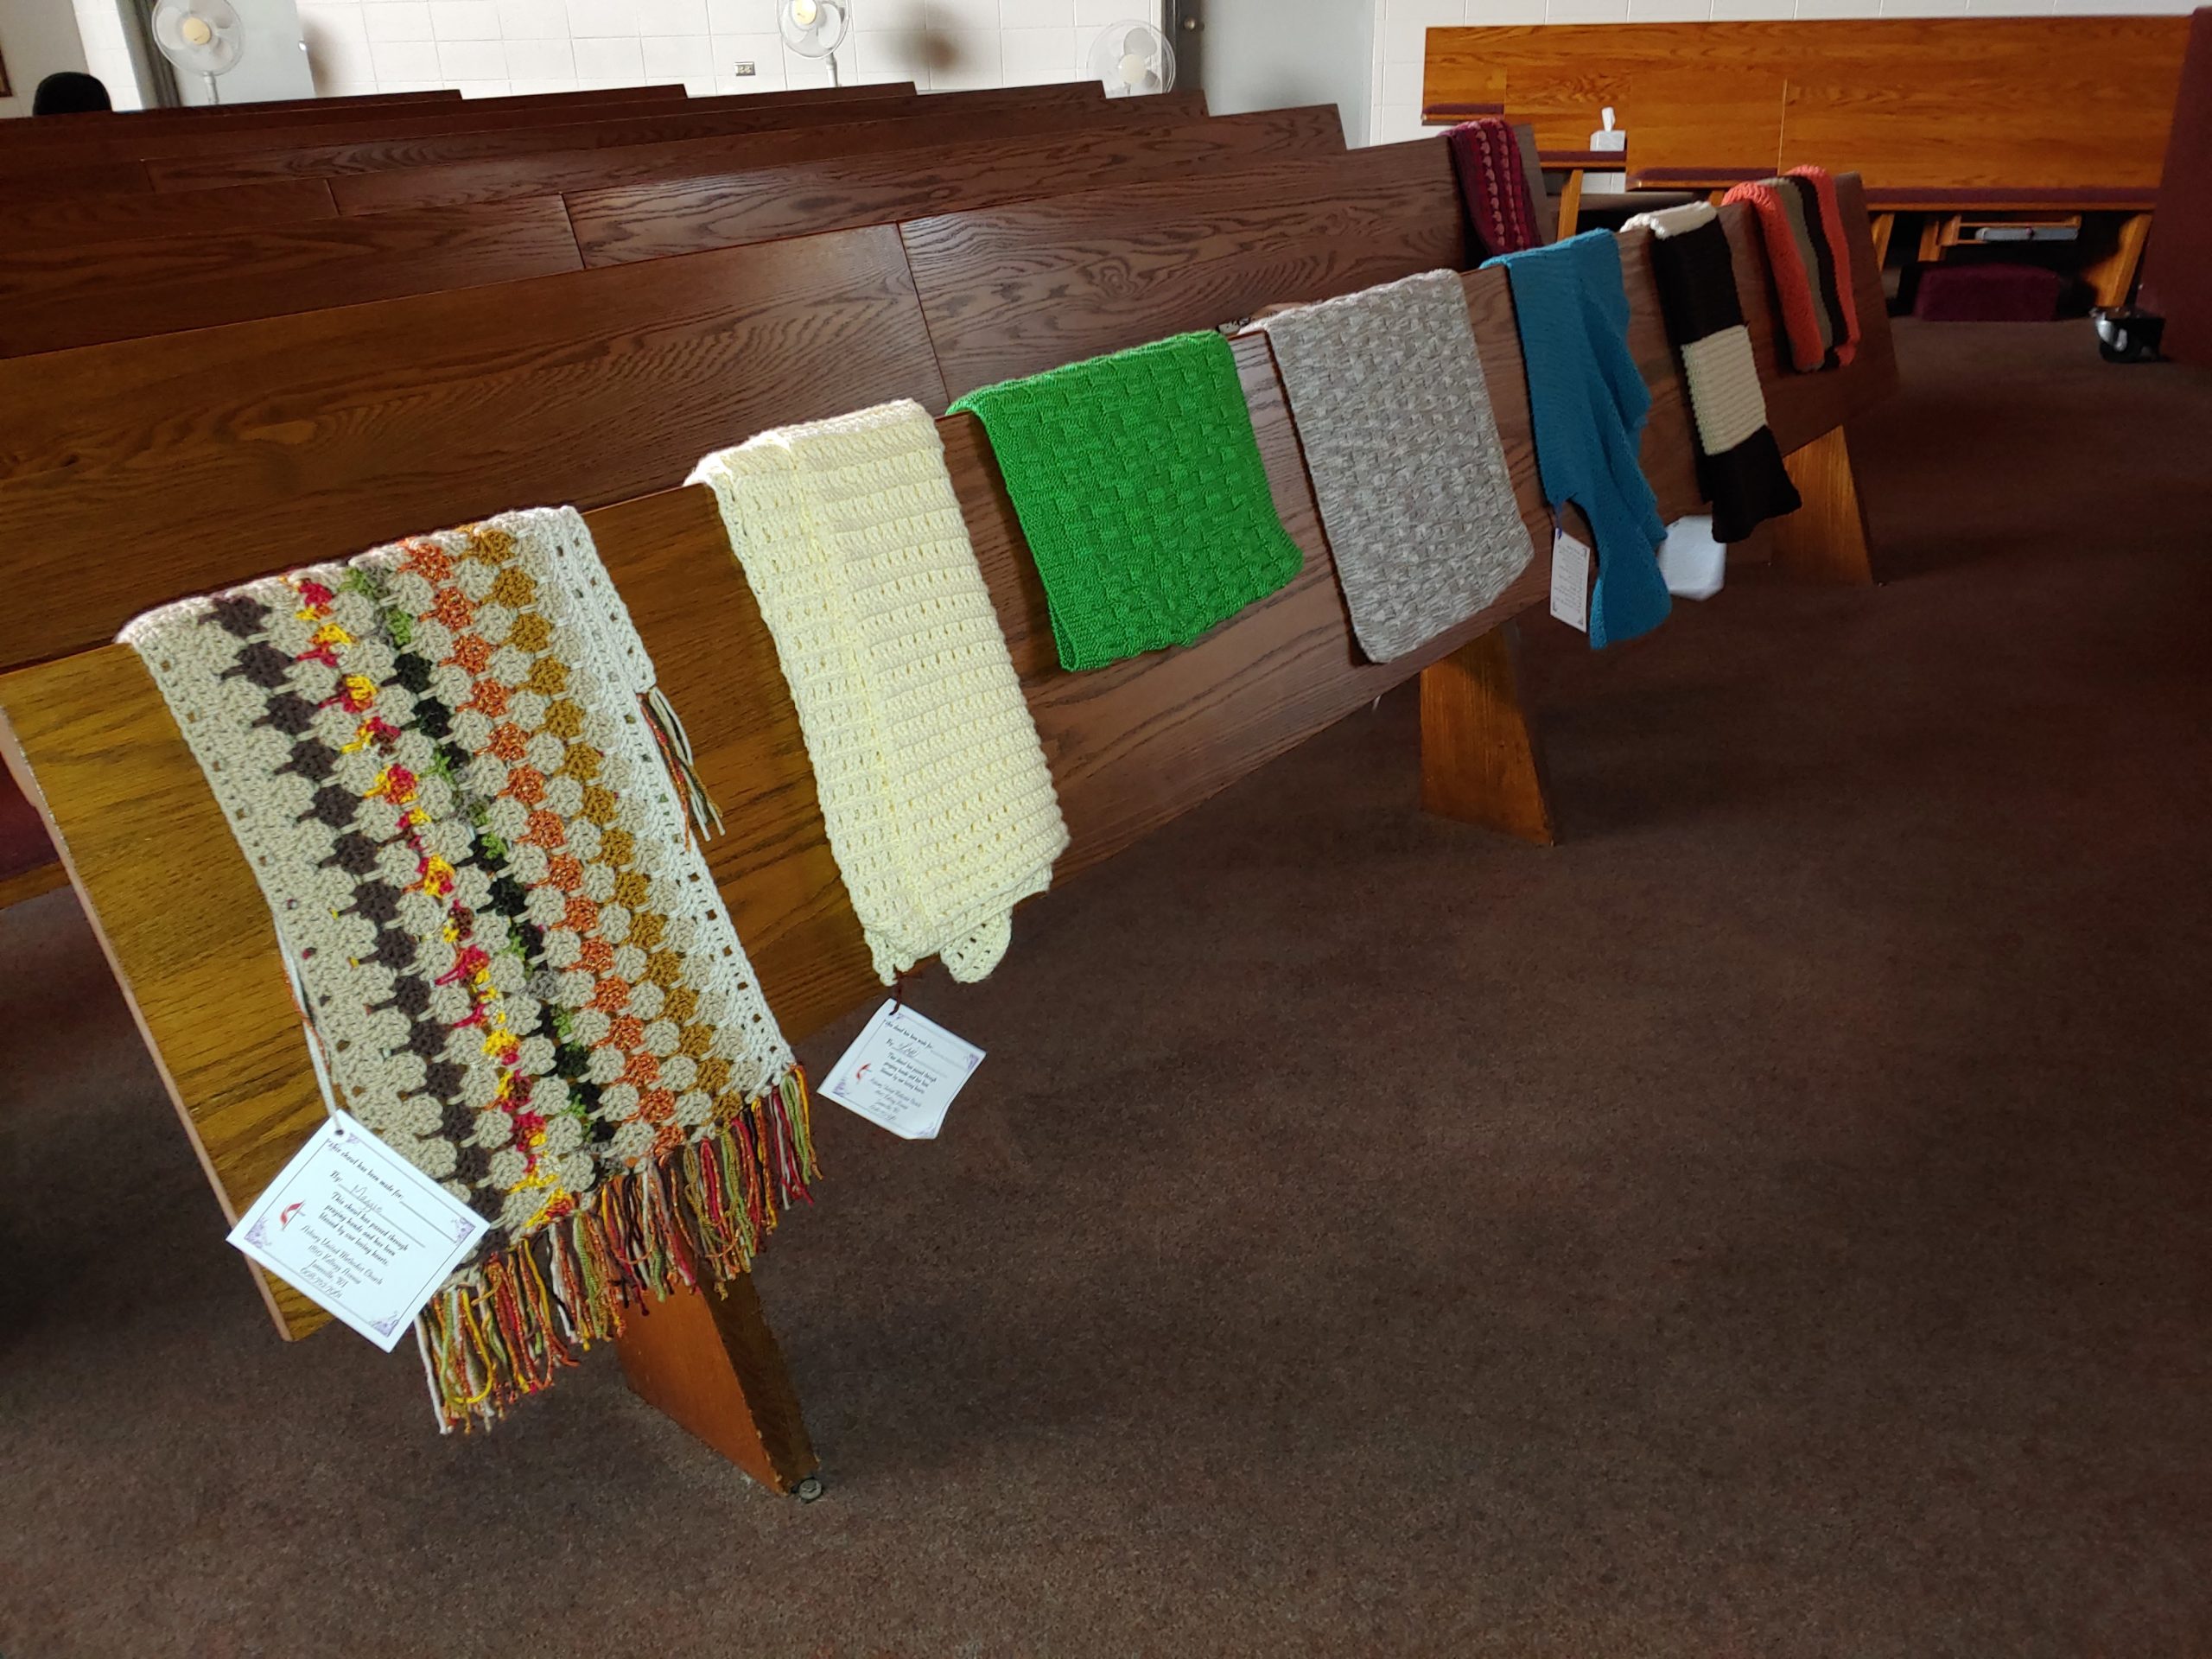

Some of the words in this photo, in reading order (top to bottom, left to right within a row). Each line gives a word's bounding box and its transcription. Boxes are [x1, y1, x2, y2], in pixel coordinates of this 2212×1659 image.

[356, 1161, 368, 1173] has
[366, 1168, 379, 1181] been
[378, 1179, 394, 1192] made
[323, 1205, 346, 1223] praying
[346, 1217, 363, 1233] hands
[361, 1230, 375, 1241] and
[372, 1236, 384, 1248] has
[383, 1243, 396, 1256] been
[331, 1191, 345, 1205] This
[359, 1212, 371, 1224] has
[386, 1233, 409, 1252] through
[336, 1224, 346, 1236] by
[344, 1232, 356, 1242] our
